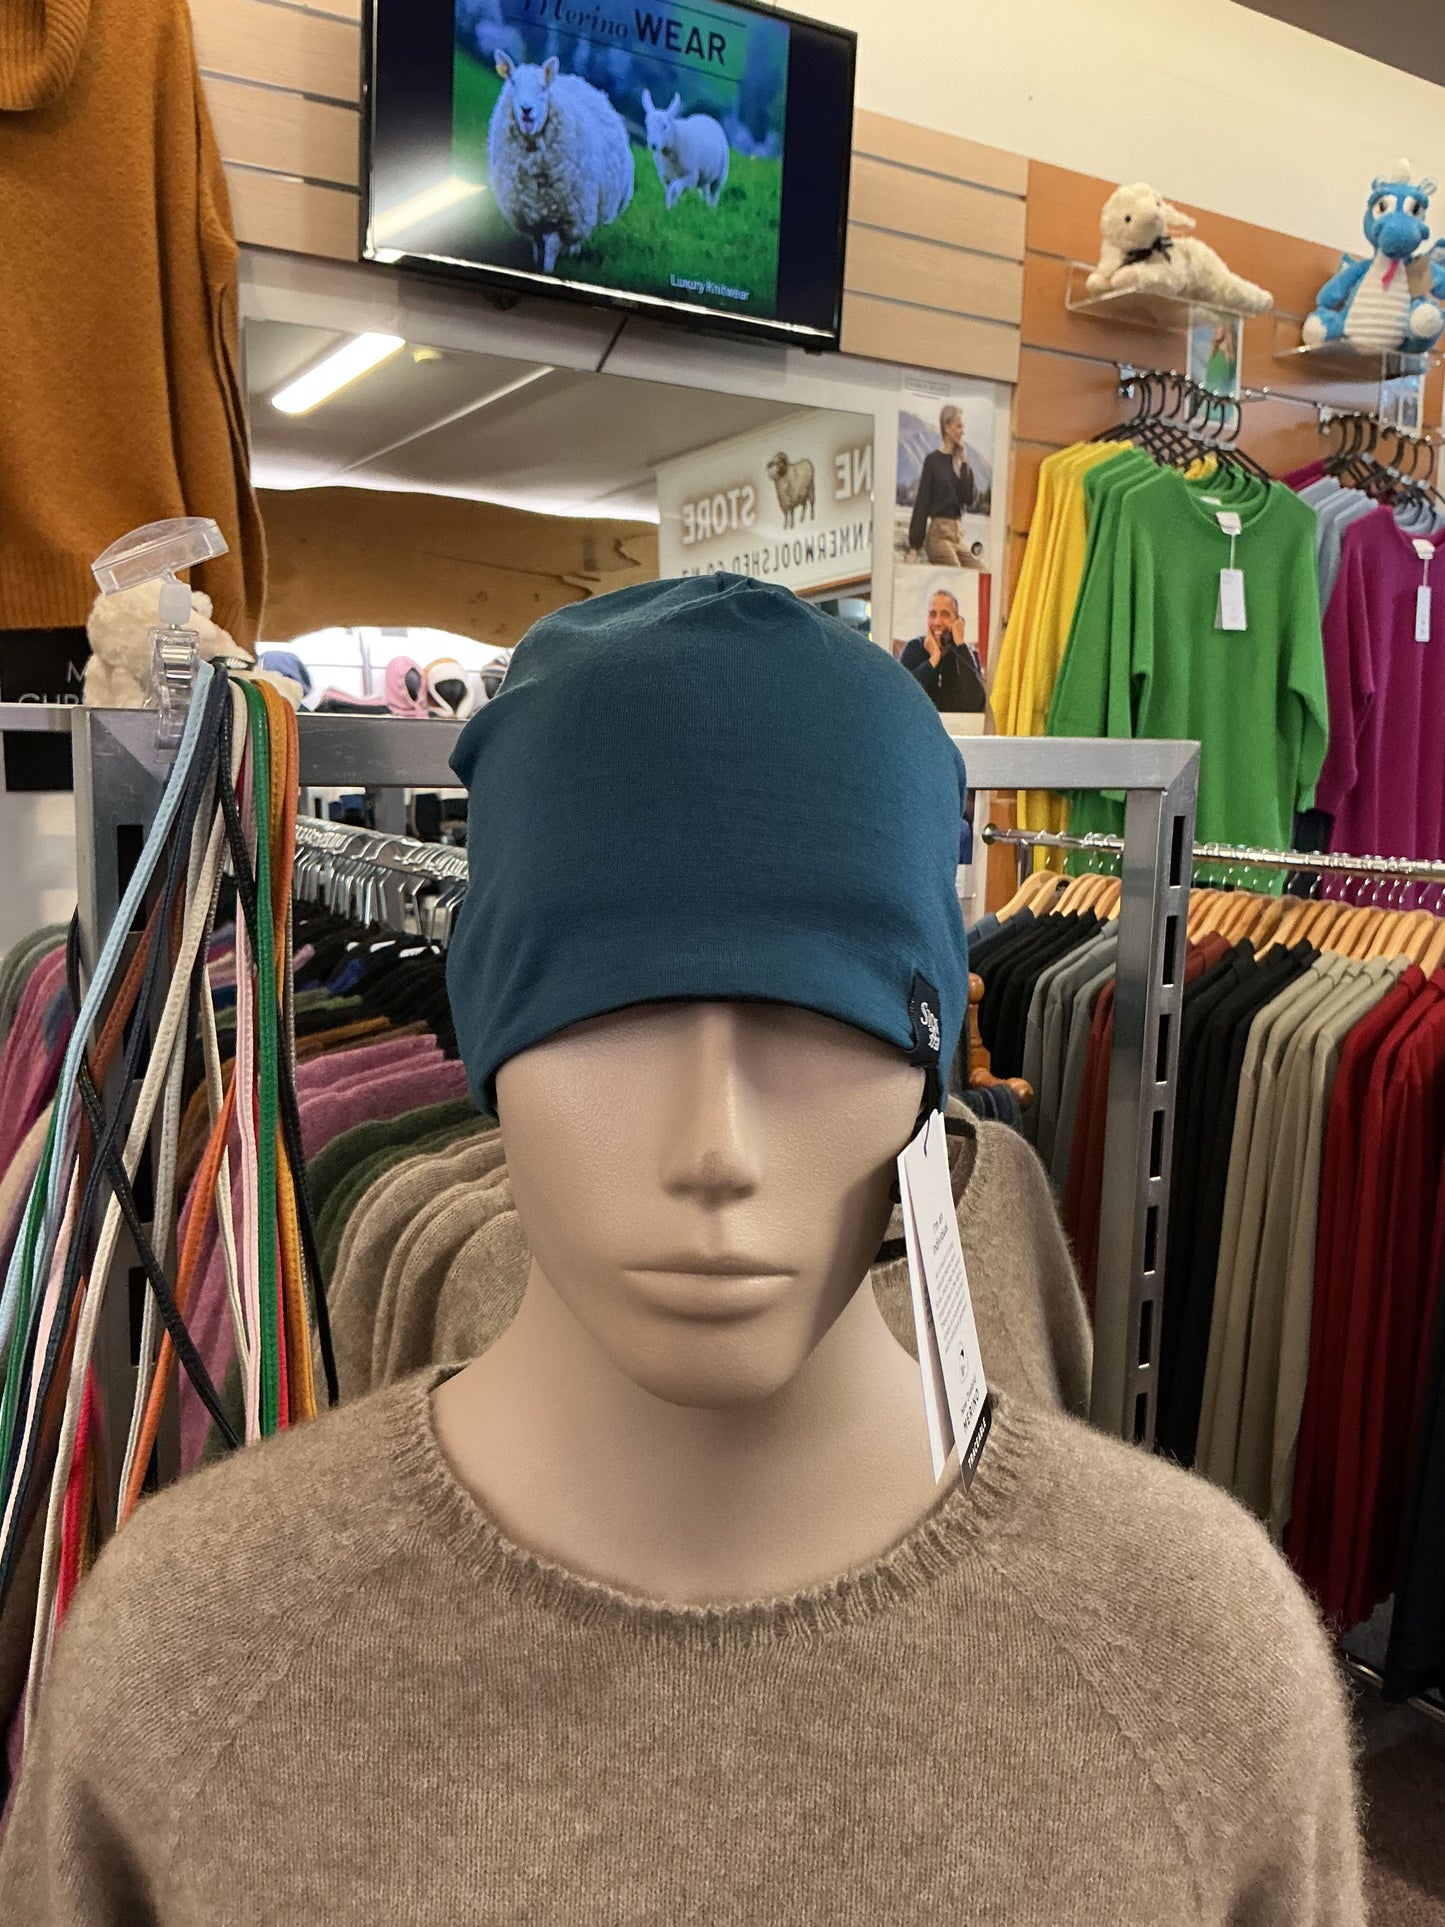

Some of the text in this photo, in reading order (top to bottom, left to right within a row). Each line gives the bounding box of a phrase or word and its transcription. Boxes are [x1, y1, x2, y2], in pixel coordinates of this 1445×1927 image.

[634, 9, 727, 66] WEAR
[670, 274, 705, 295] Luxury
[963, 1387, 980, 1434] MERINO
[967, 1416, 987, 1469] TRACEABLE
